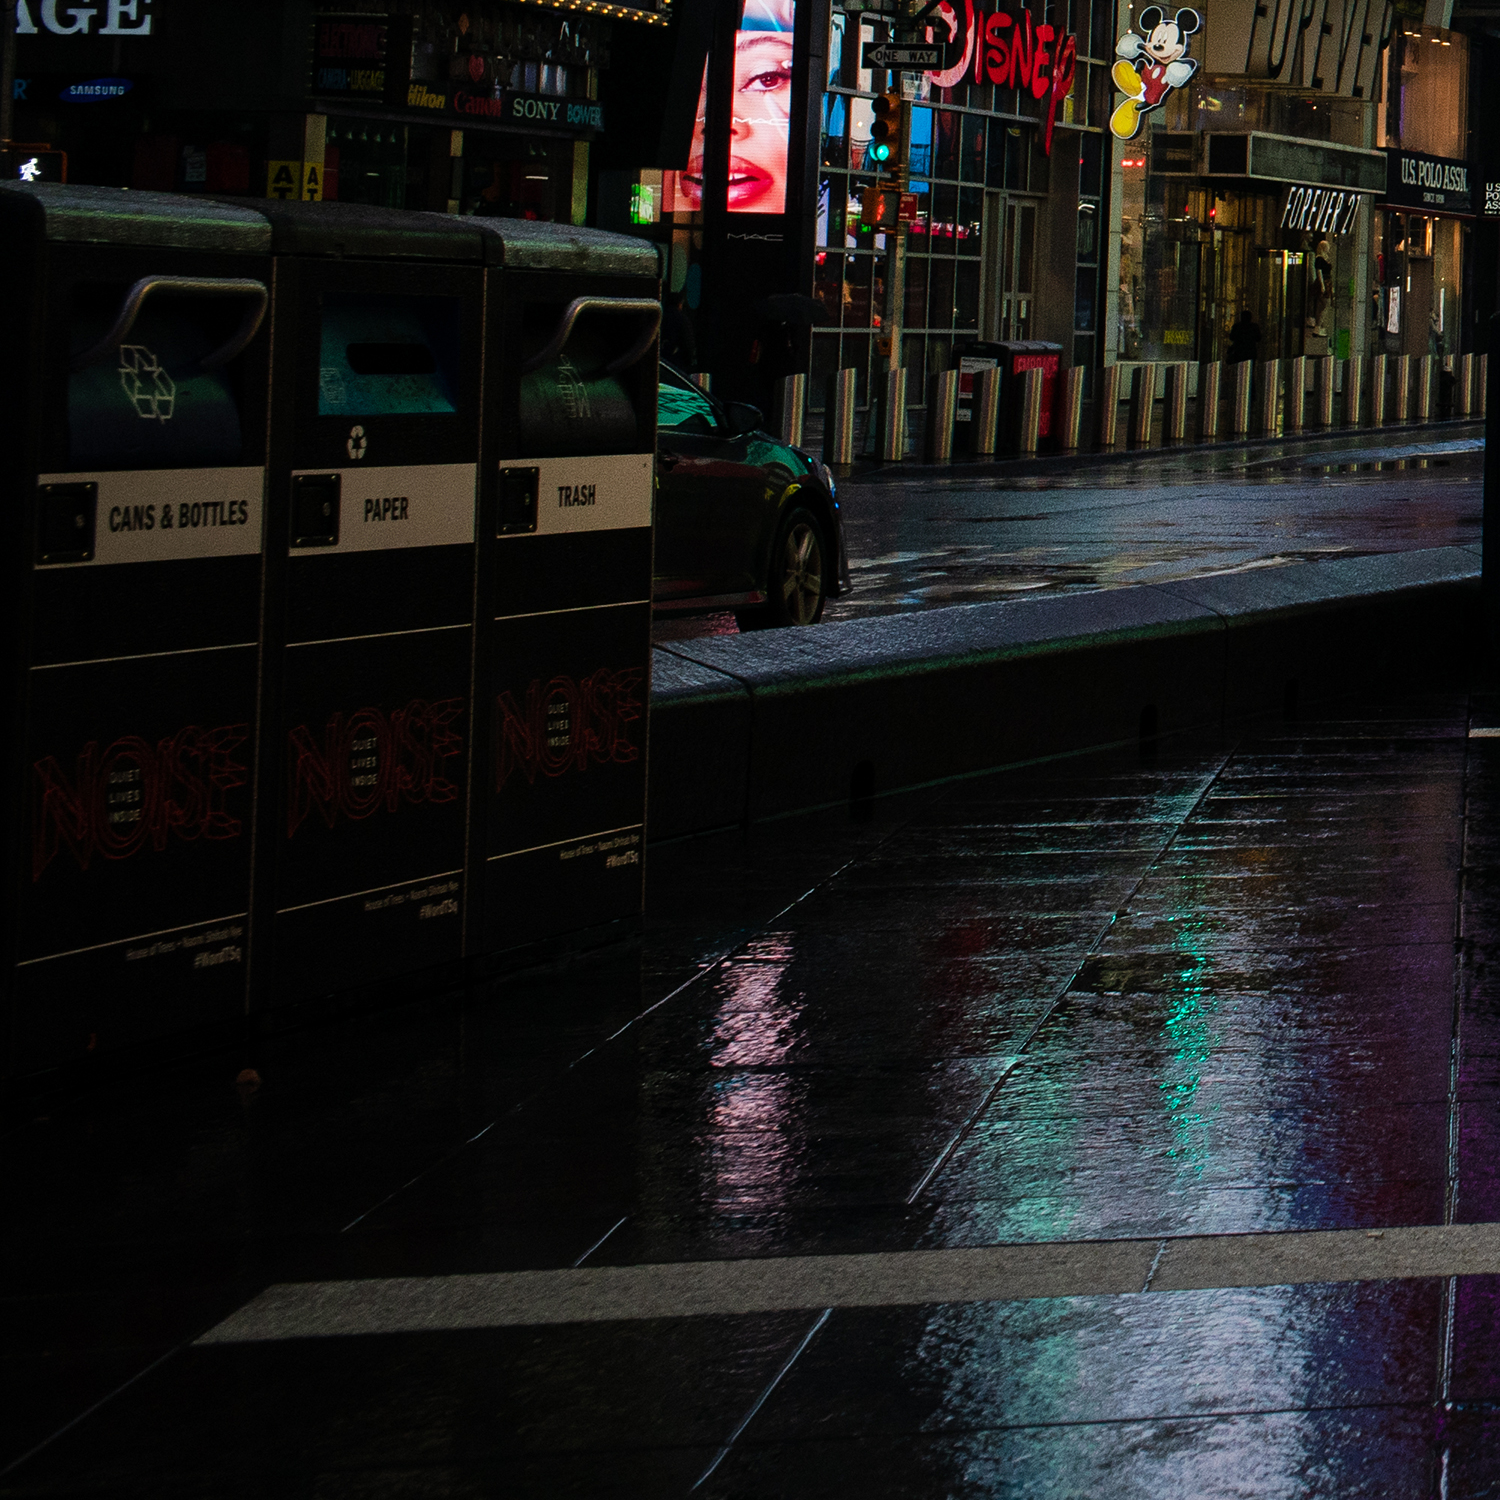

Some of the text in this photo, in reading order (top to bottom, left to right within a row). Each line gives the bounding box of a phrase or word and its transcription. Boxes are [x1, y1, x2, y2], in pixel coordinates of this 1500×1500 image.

[875, 49, 935, 64] ONE WAY
[69, 84, 126, 98] SAMSUNG
[407, 83, 603, 126] Nikon Canon SONY BOWER
[1400, 157, 1469, 193] U.S. POLO ASSN.
[1279, 185, 1362, 235] FOREVER 21
[363, 496, 409, 523] PAPER
[557, 483, 597, 509] TRASH
[109, 499, 249, 533] CANS & BOTTLES
